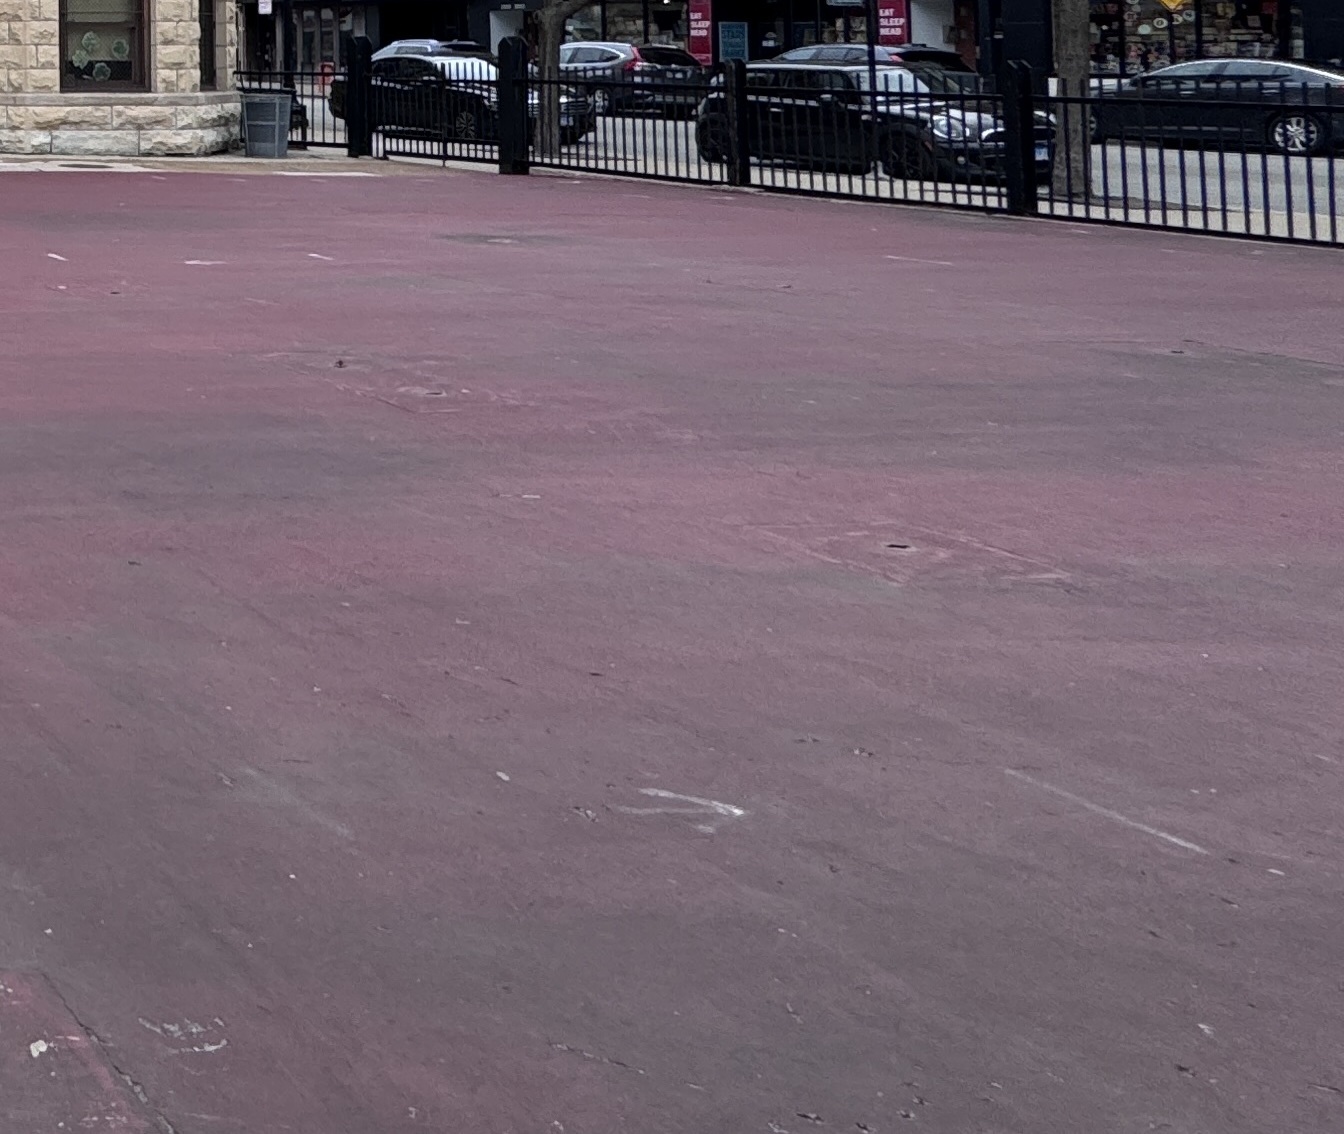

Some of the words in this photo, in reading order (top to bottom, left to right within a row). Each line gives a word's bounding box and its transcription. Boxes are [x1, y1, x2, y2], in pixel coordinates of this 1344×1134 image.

[879, 8, 895, 17] EAT
[879, 17, 905, 26] SLEEP
[879, 27, 902, 36] READ
